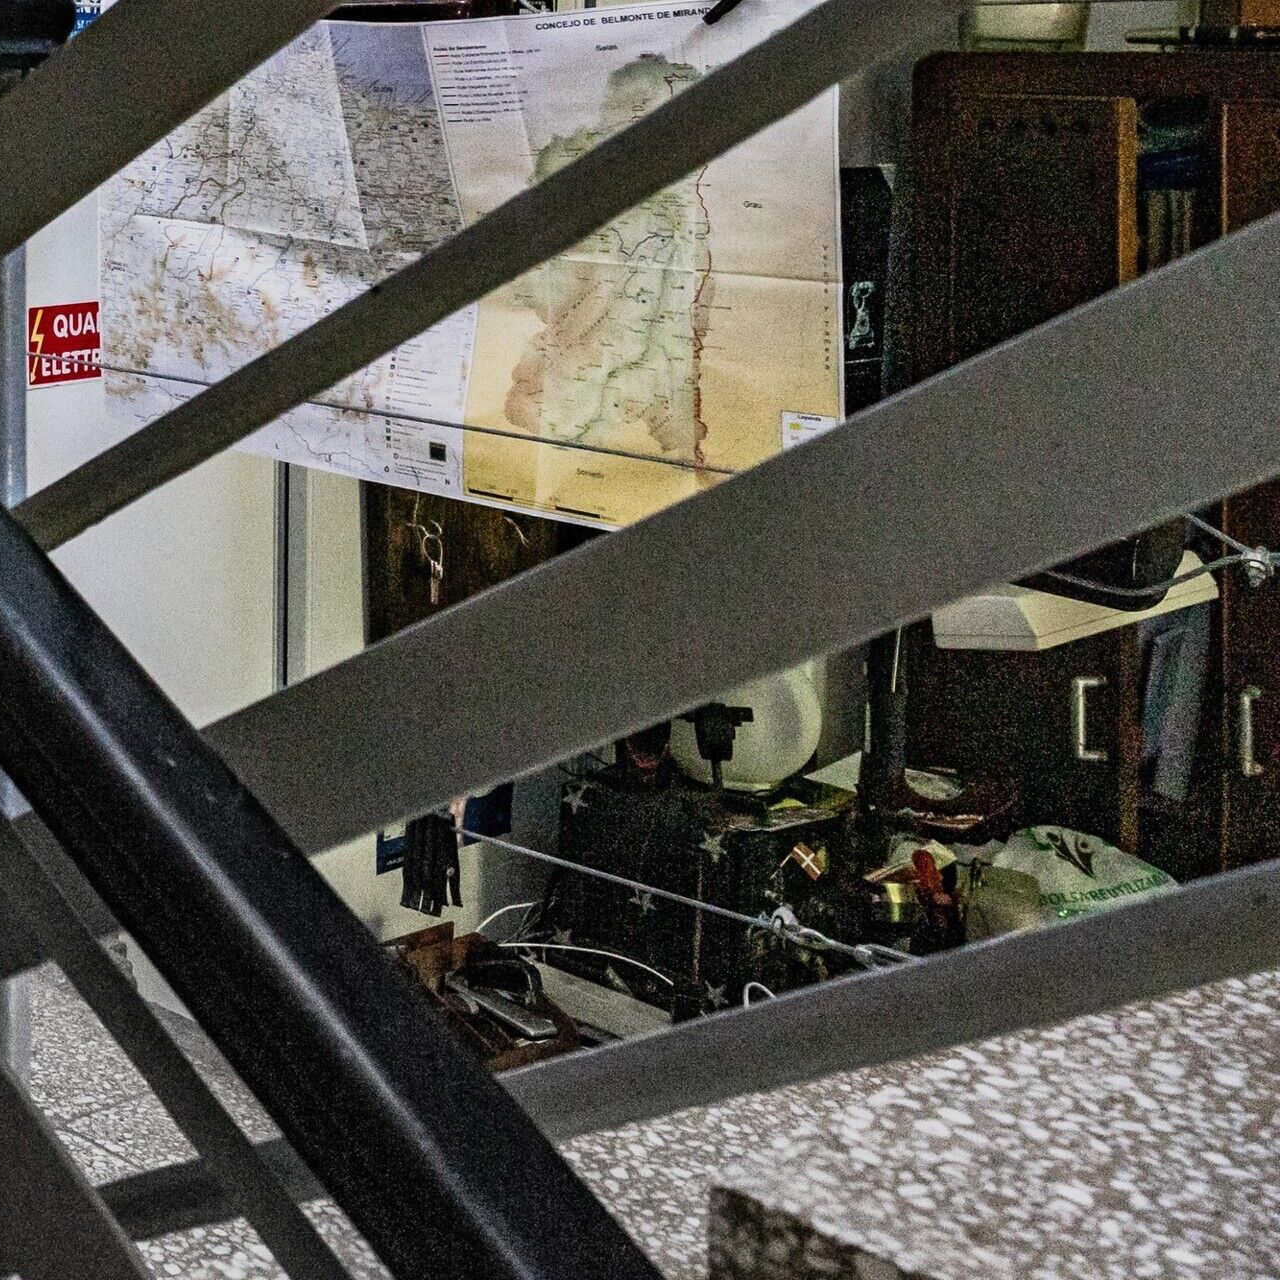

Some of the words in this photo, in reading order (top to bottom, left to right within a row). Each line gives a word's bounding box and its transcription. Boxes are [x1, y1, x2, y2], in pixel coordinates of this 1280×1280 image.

[535, 20, 581, 31] CONCEJO
[583, 18, 596, 26] DE
[600, 13, 655, 25] BELMONTE
[657, 11, 670, 19] DE
[672, 6, 711, 18] MIRAND
